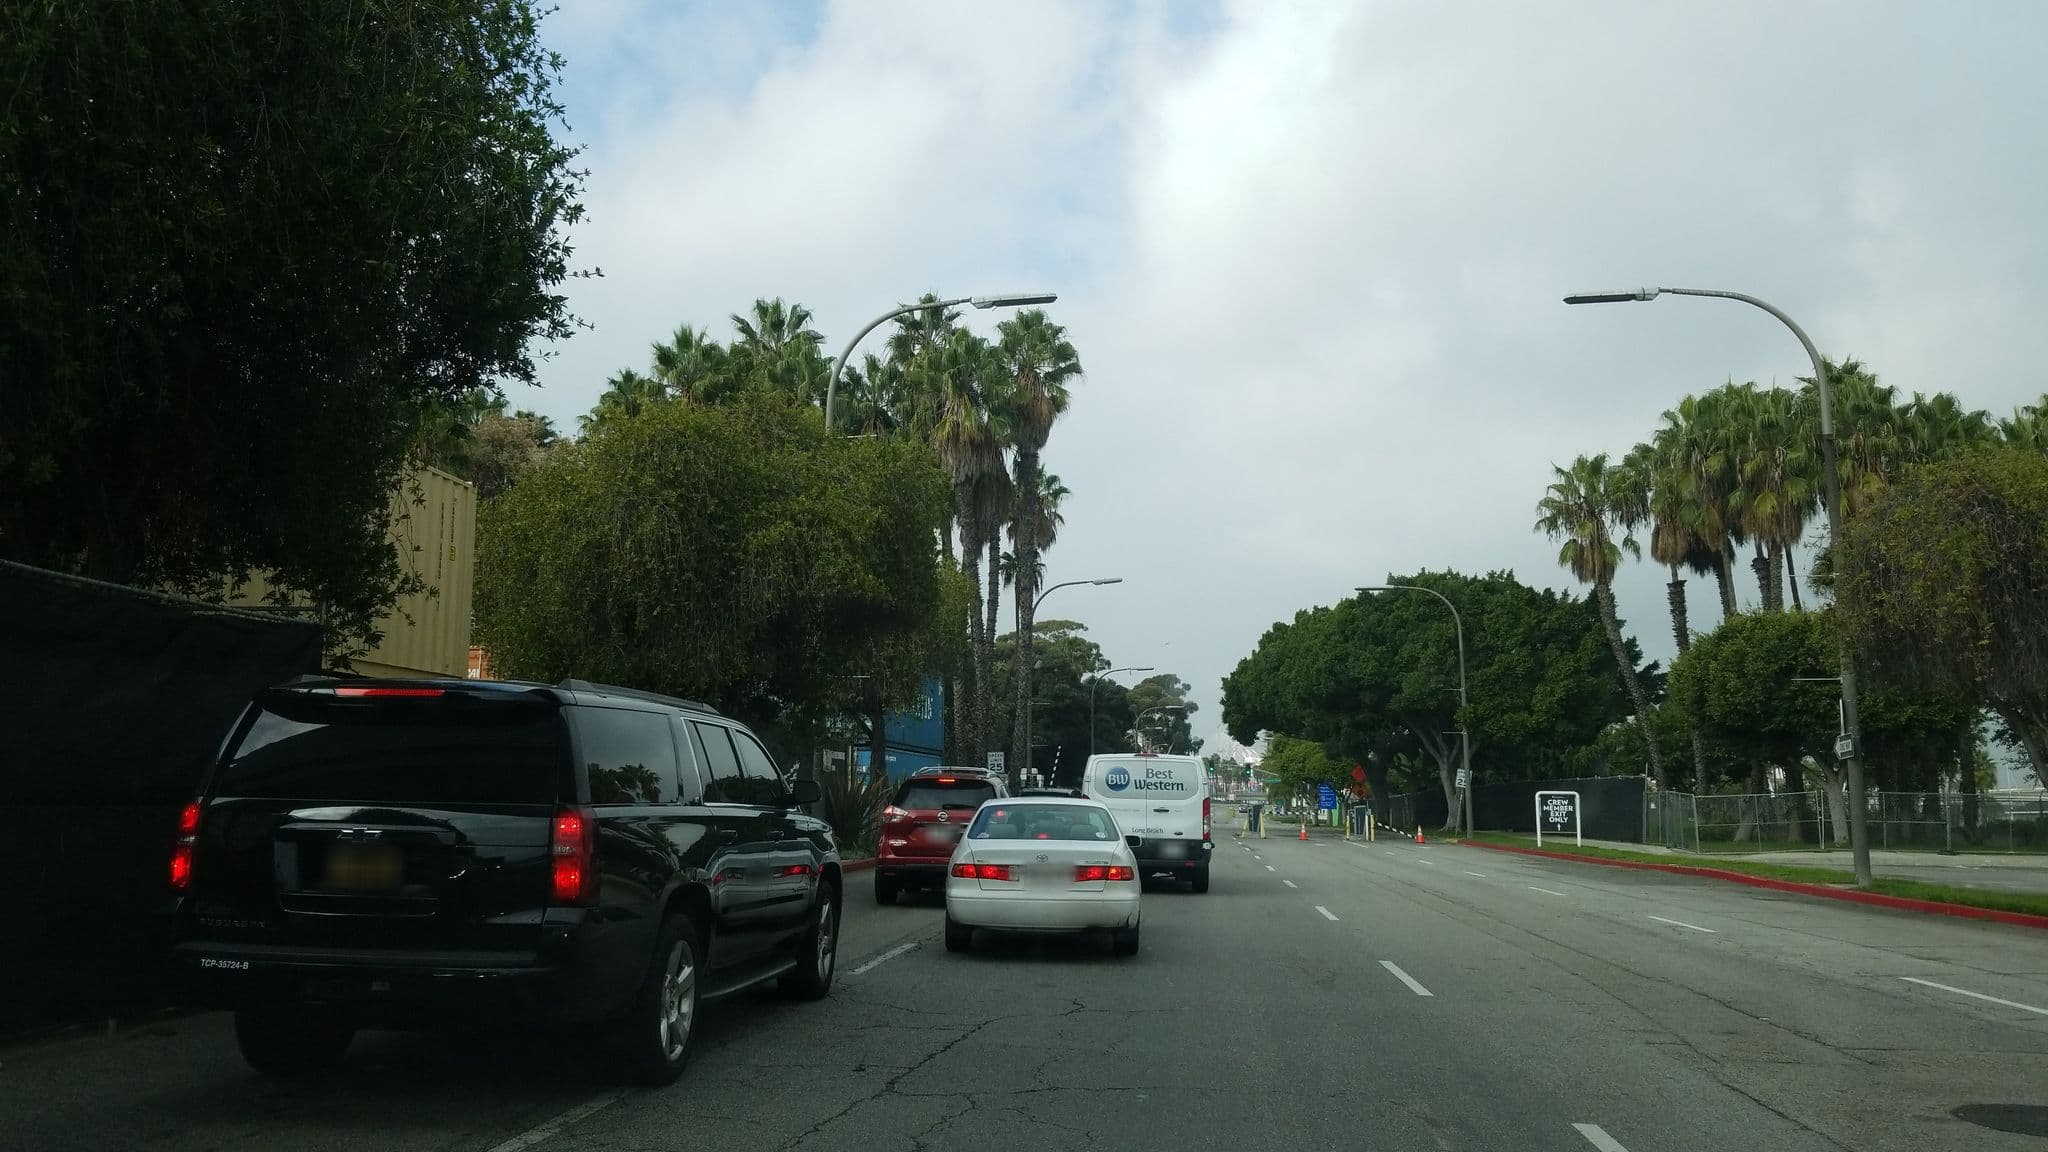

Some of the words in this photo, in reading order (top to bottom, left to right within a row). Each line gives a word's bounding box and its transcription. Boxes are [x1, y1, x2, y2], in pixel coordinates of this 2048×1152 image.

[990, 763, 1002, 771] 25
[1146, 768, 1173, 779] Best
[1108, 774, 1128, 785] BW
[1134, 779, 1184, 791] Western
[200, 958, 249, 970] TCP-35724-B
